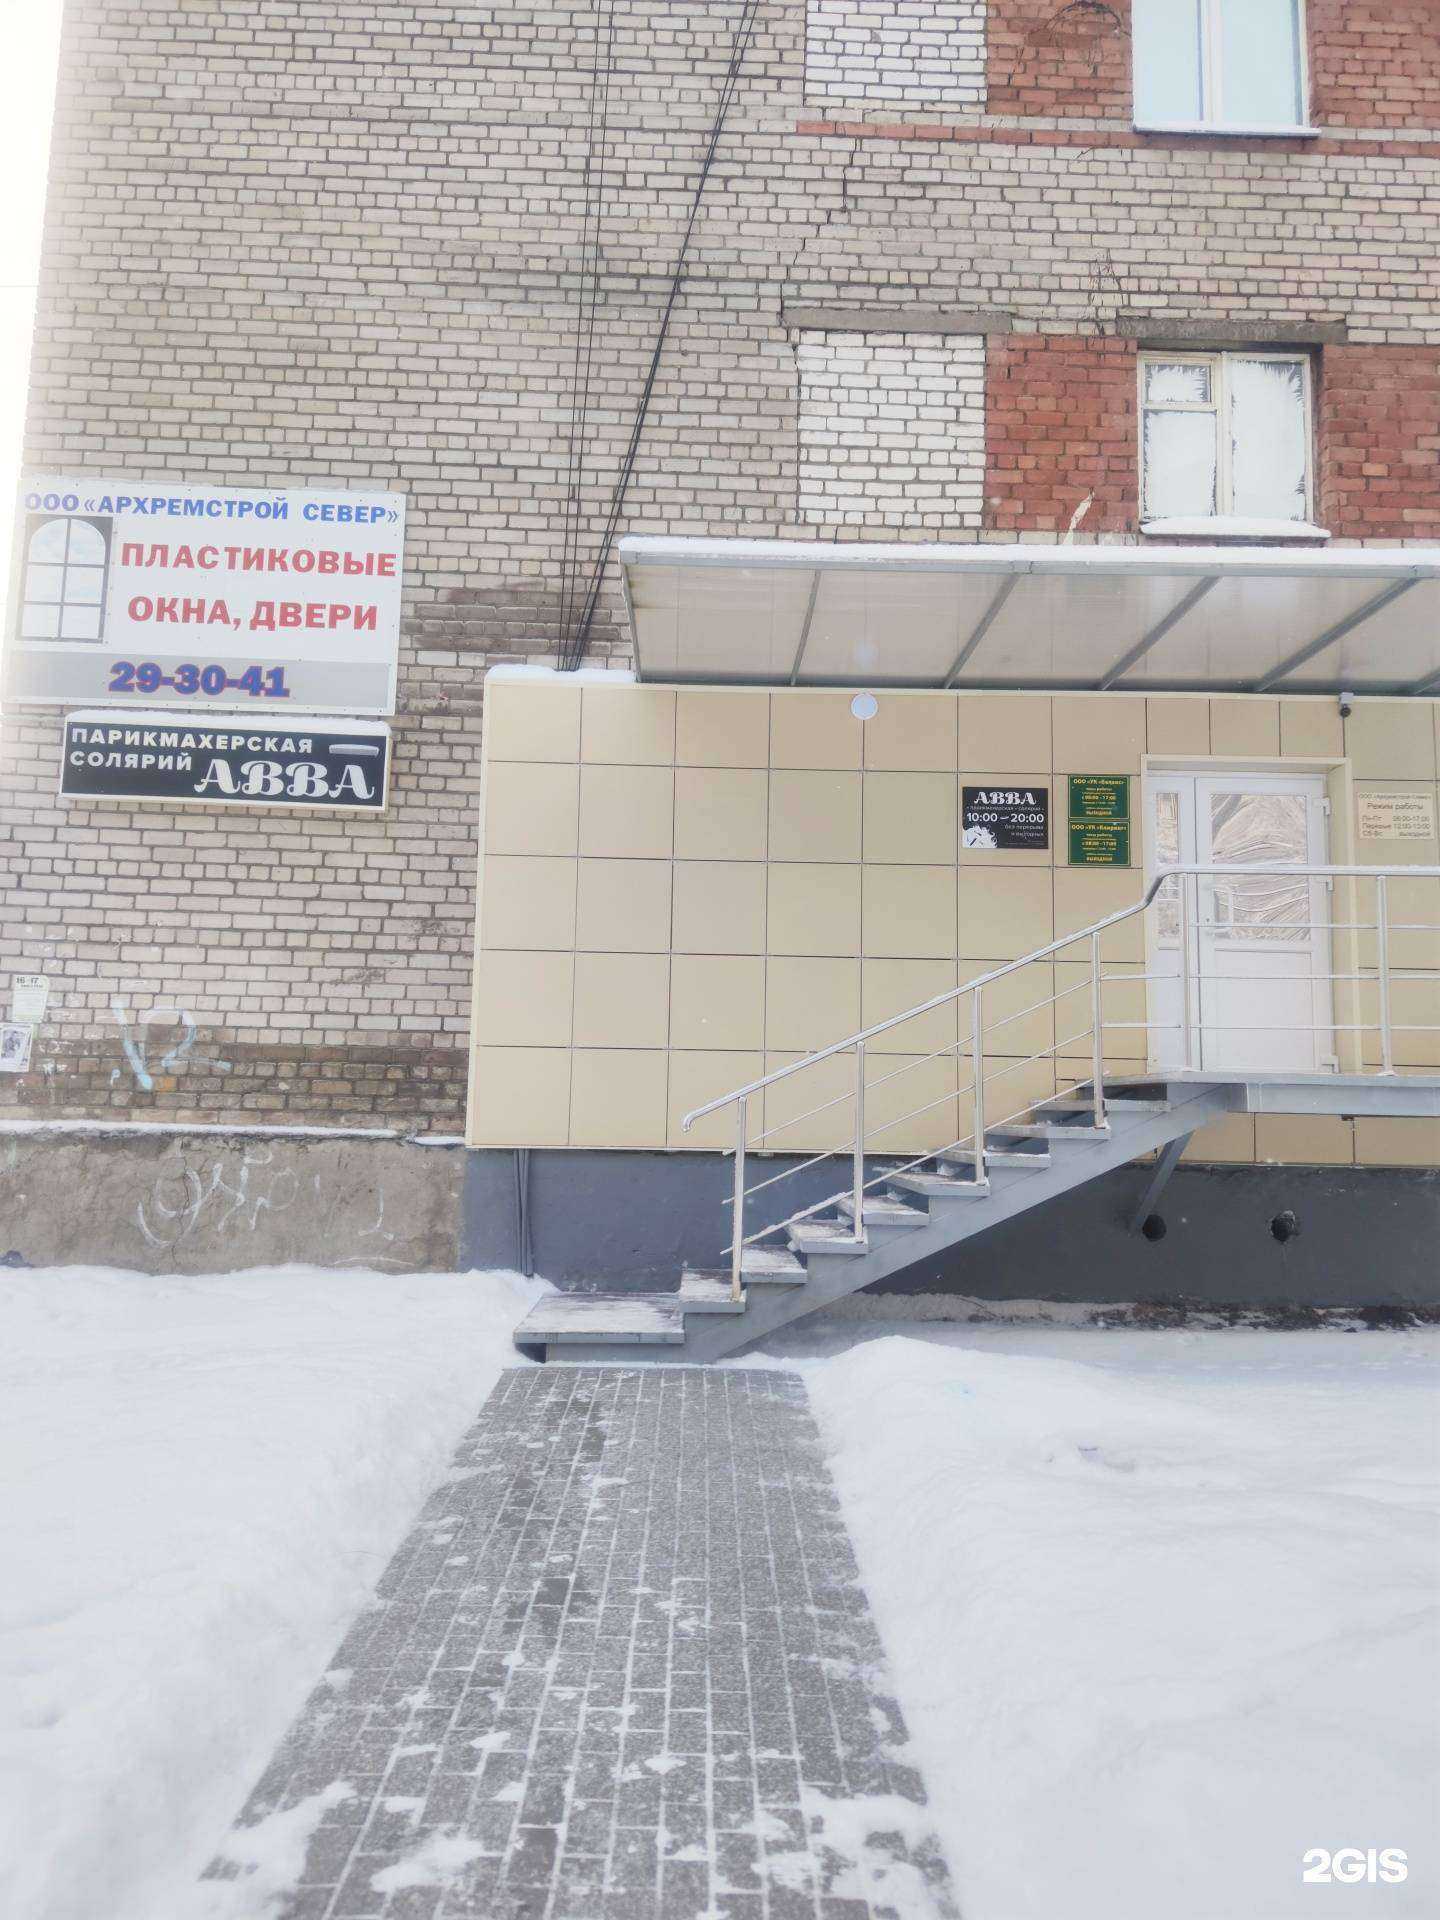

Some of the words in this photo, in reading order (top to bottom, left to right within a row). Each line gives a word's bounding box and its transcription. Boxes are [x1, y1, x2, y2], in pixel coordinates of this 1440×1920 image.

[24, 493, 79, 512] ООО
[84, 495, 289, 521] «АРХРЕМСТРОЙ
[302, 502, 399, 524] СЕВЕР»
[121, 542, 397, 577] ПЛАСТИКОВЫЕ
[127, 595, 242, 632] ОКНА,
[249, 600, 378, 632] ДВЕРИ
[108, 660, 291, 698] 29-30-41
[71, 727, 313, 754] ПАРИКМАХЕРСКАЯ
[70, 750, 193, 771] СОЛЯРИЙ
[966, 812, 998, 822] 10:00
[1010, 813, 1045, 823] 20:00
[1394, 801, 1424, 811] работы
